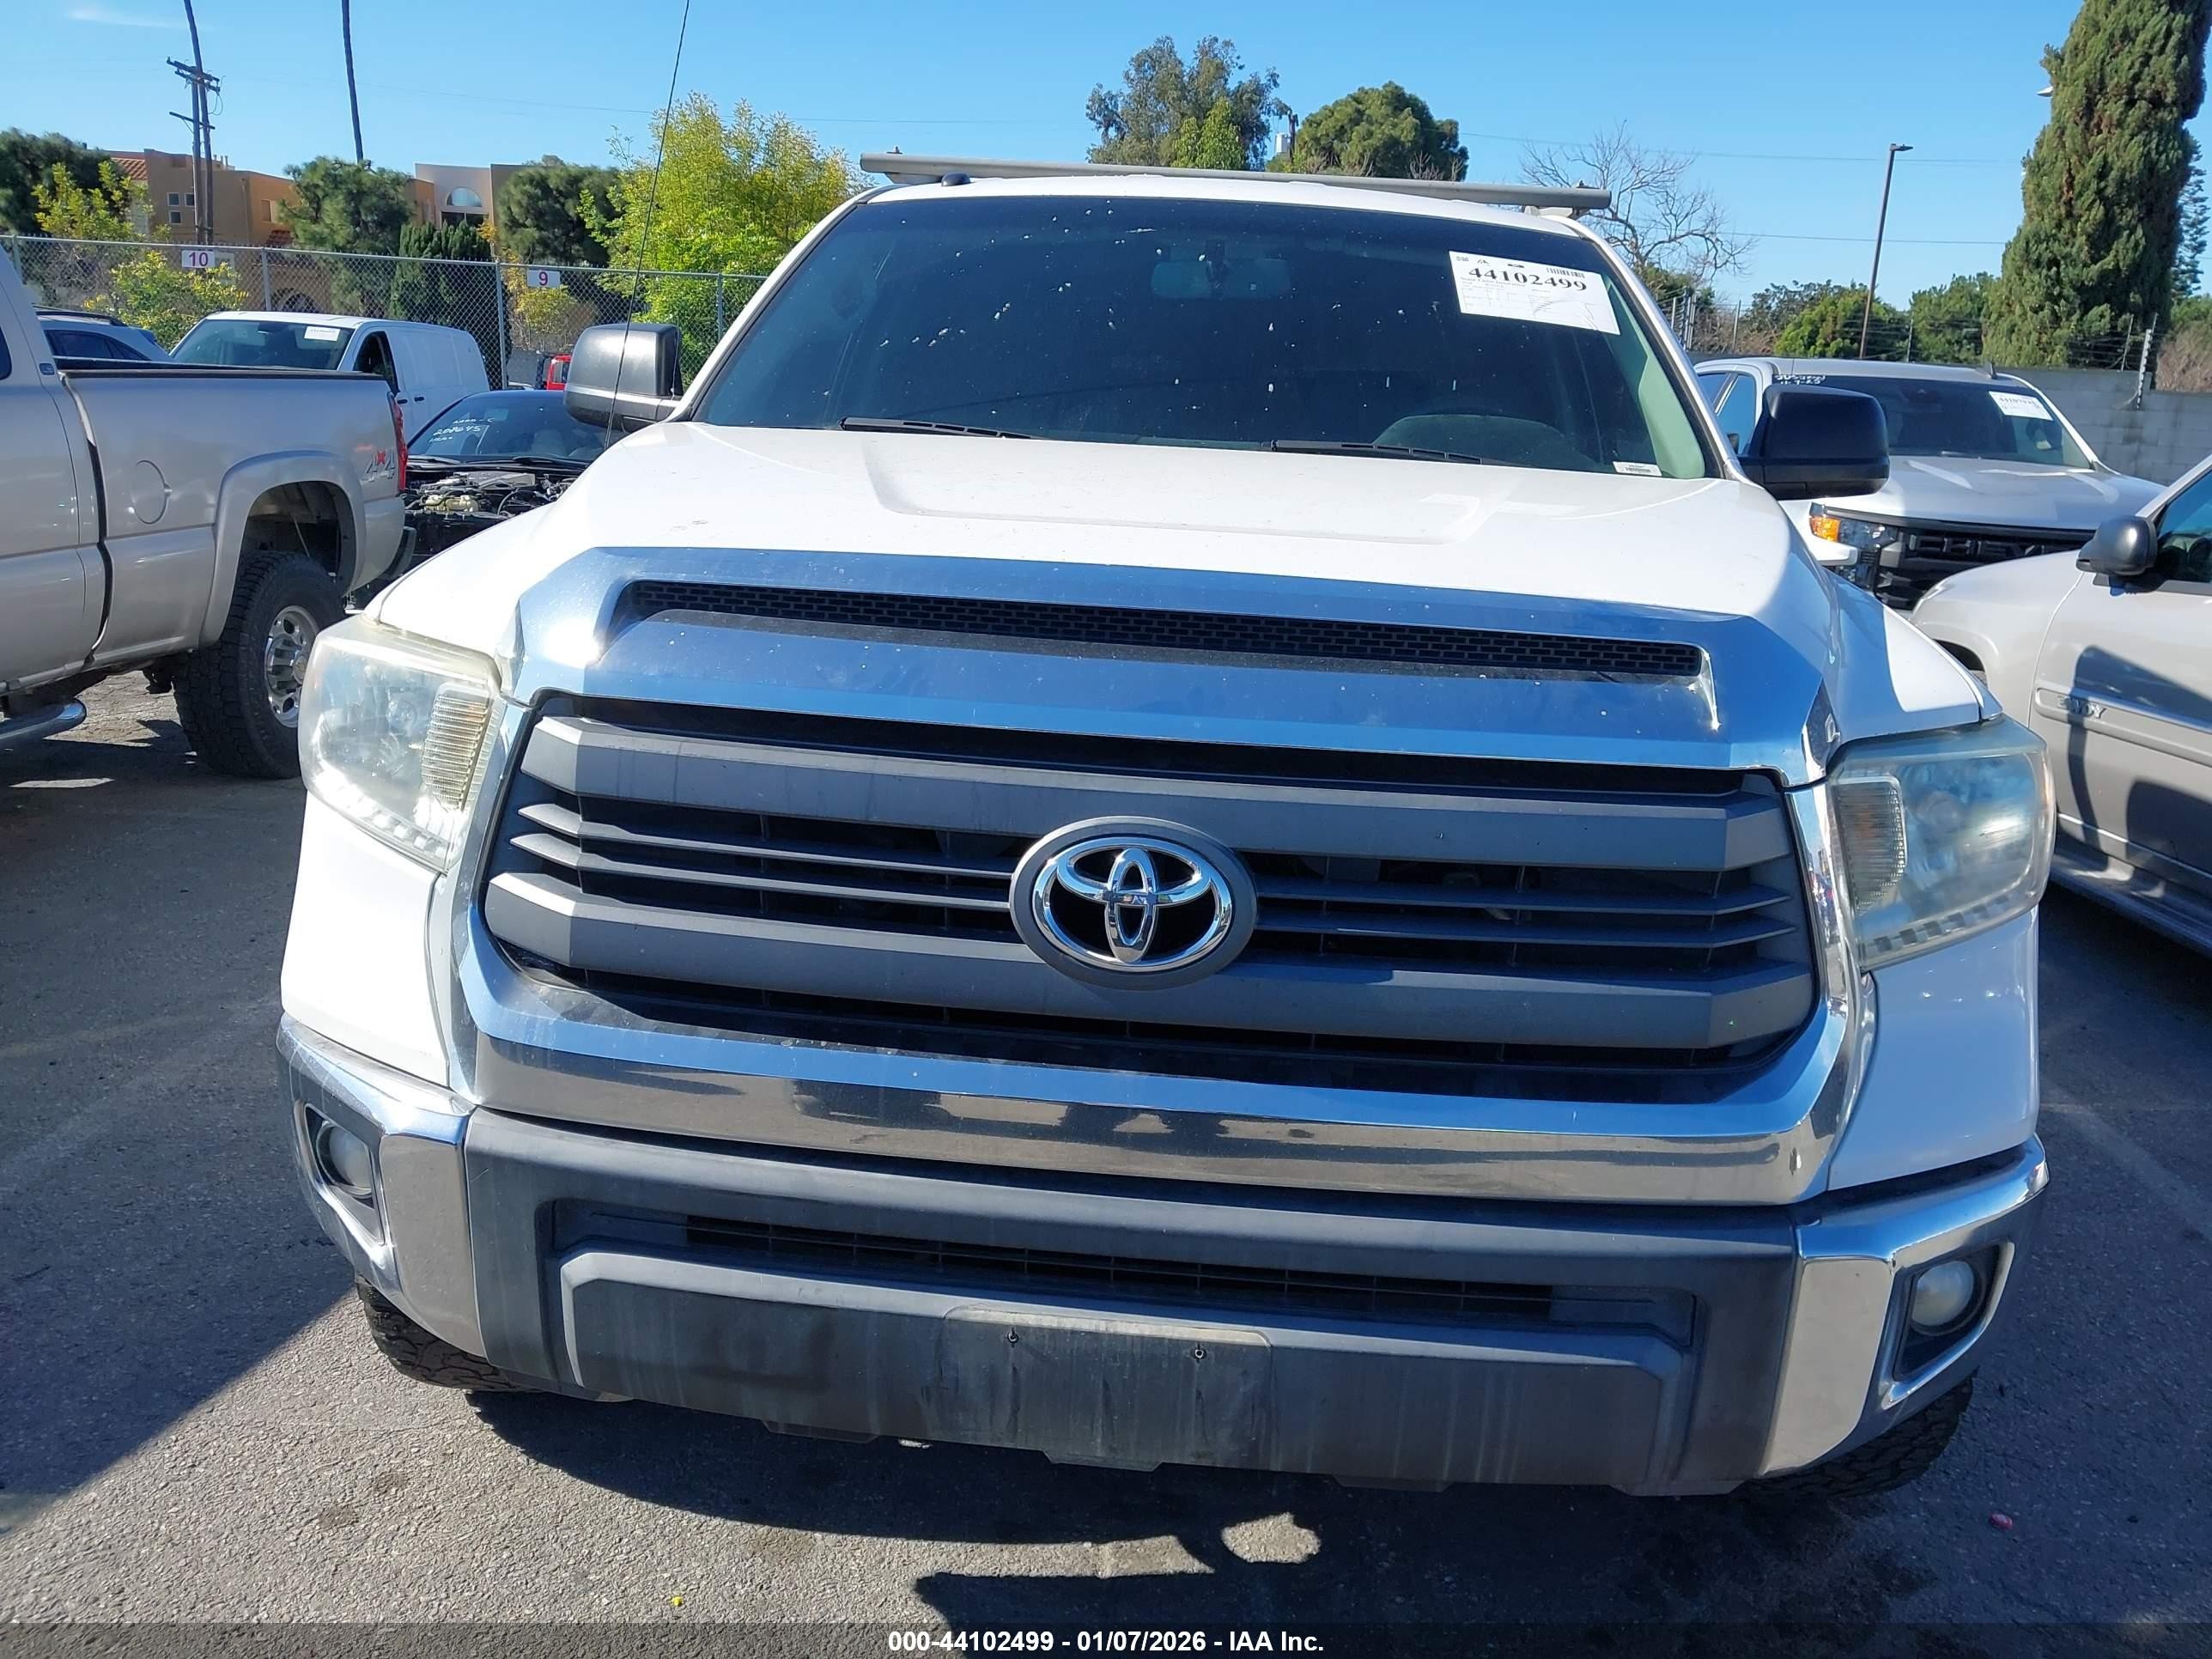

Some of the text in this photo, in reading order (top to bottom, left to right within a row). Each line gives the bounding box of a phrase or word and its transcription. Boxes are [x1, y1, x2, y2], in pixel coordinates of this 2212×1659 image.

[188, 252, 209, 267] 10
[538, 271, 549, 286] 9
[1468, 267, 1588, 292] 44102499
